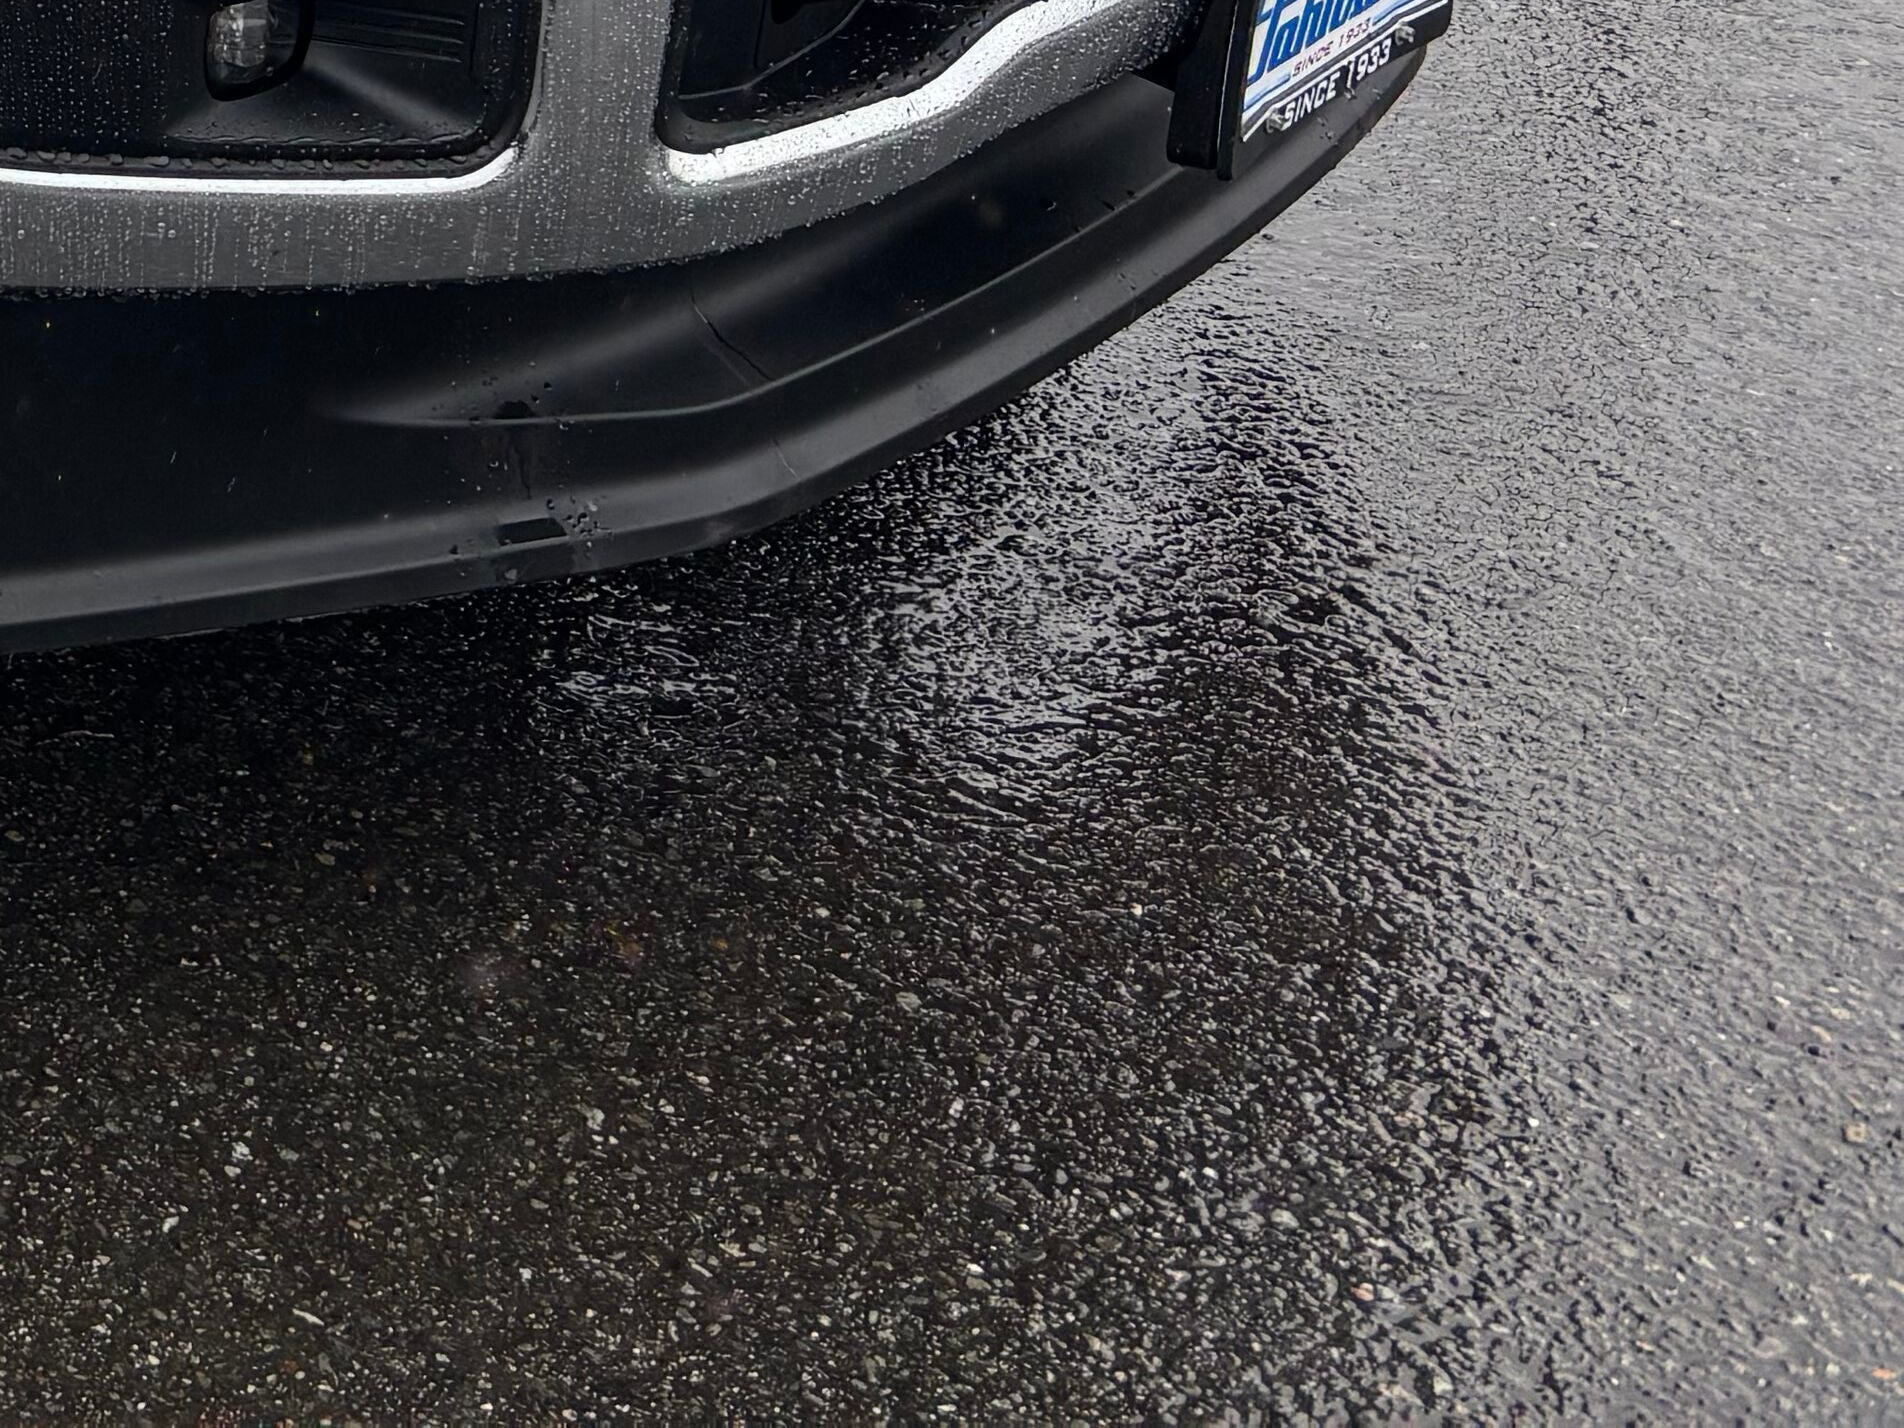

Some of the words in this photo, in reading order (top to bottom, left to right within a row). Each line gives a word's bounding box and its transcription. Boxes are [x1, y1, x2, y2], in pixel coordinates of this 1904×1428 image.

[1281, 70, 1341, 131] SINCE
[1343, 36, 1393, 92] 1933
[1292, 40, 1334, 77] SINCE
